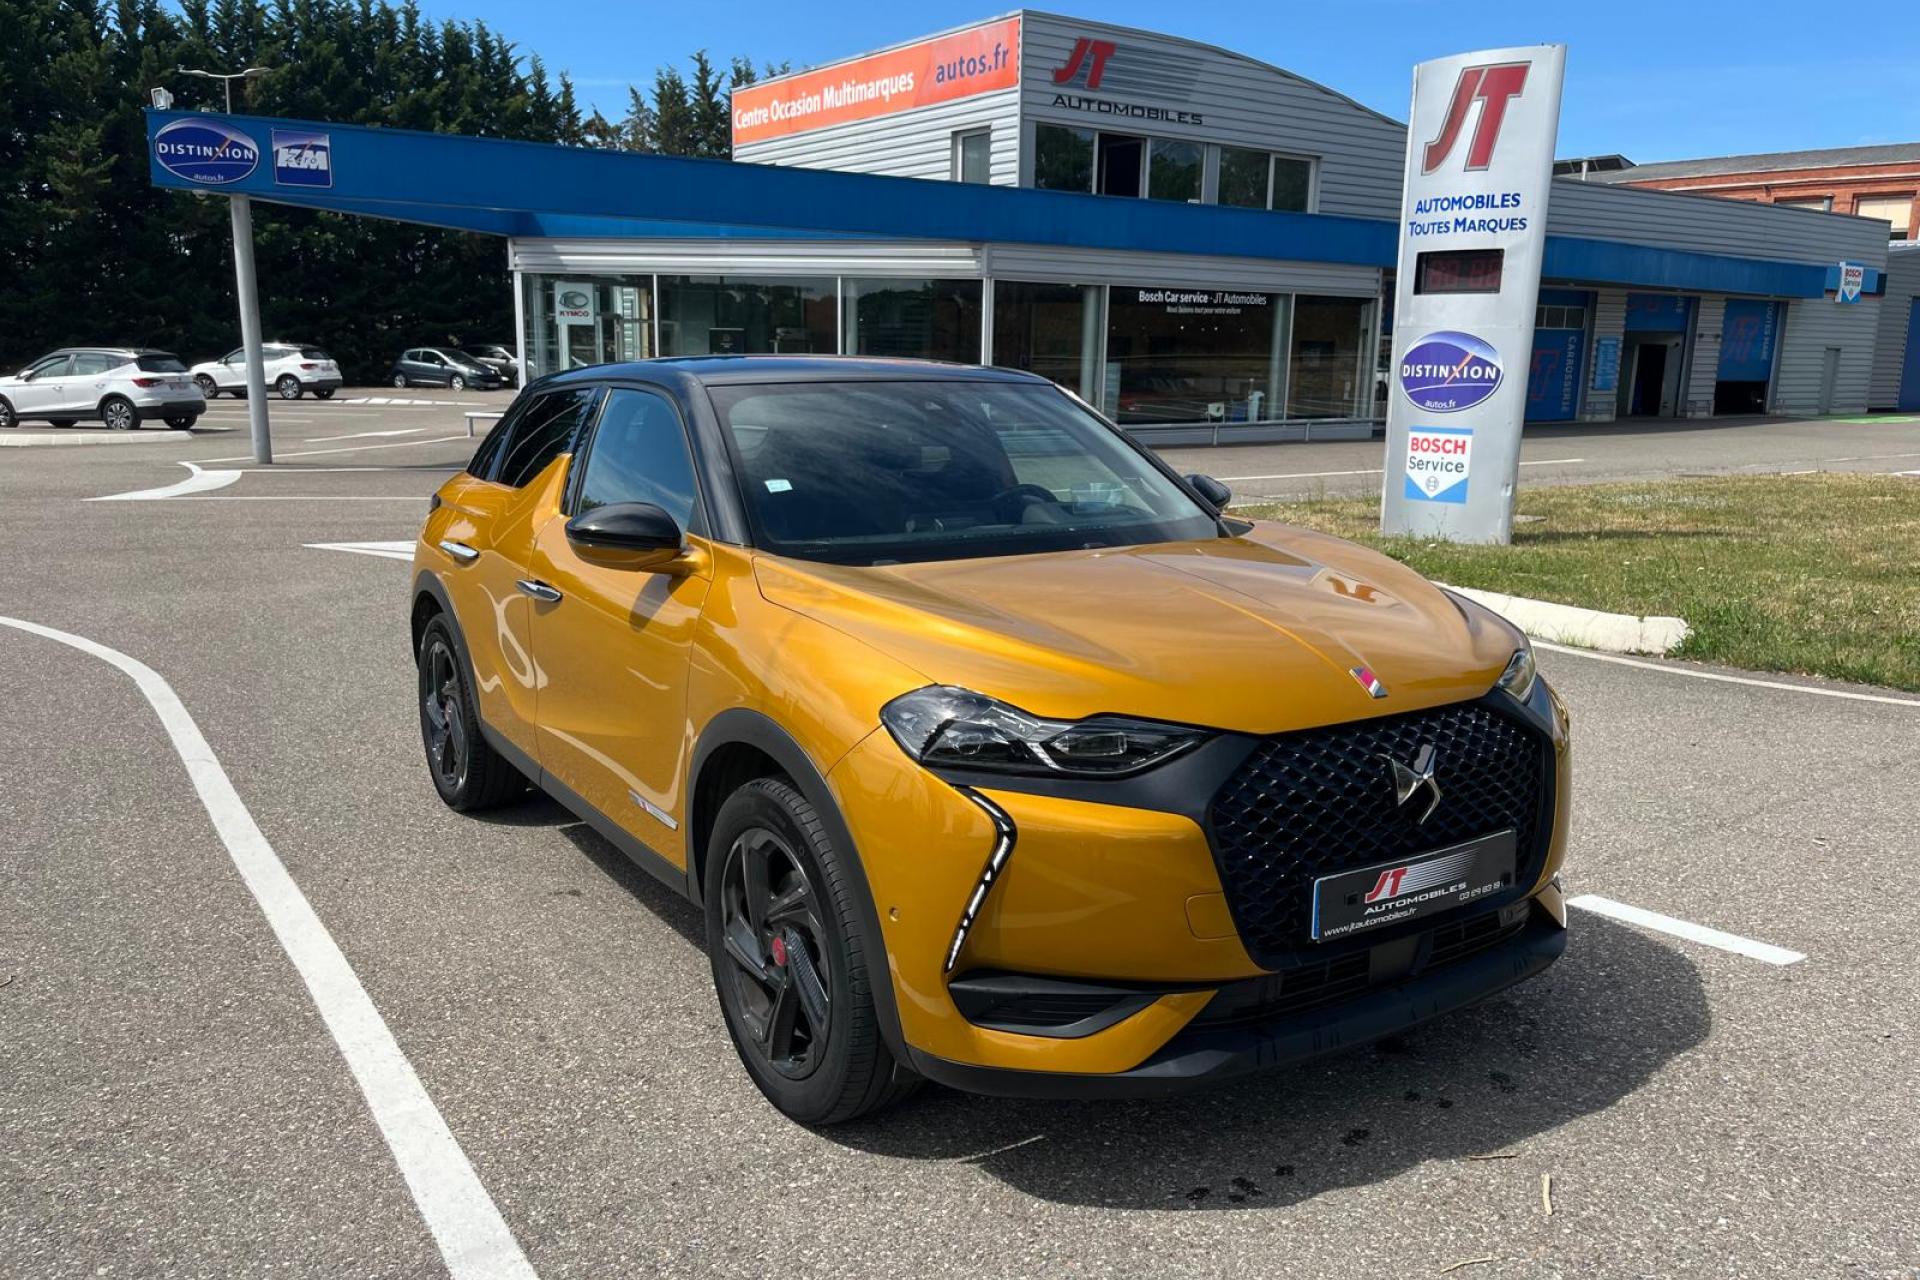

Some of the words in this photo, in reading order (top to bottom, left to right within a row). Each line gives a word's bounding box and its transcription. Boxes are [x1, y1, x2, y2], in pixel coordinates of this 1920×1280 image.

[935, 43, 1010, 84] autos.fr
[1053, 36, 1118, 91] JT
[735, 105, 769, 130] Centre
[770, 92, 821, 121] Occasion
[822, 70, 915, 111] Multimarques
[1052, 93, 1204, 126] AUTOMOBILES
[1421, 61, 1532, 176] JT
[158, 142, 254, 160] DISTINXION
[194, 172, 224, 182] autos.fr
[1415, 193, 1521, 214] AUTOMOBILES
[1845, 268, 1862, 278] BOSCH
[1138, 290, 1164, 302] Bosch
[1164, 290, 1179, 303] Car
[1180, 291, 1208, 304] service
[1212, 292, 1223, 304] JT
[1223, 293, 1267, 305] Automobiles
[1402, 364, 1497, 380] DISTINXION
[1425, 399, 1457, 409] autos.fr
[1410, 436, 1466, 455] BOSCH
[1408, 455, 1465, 474] Service
[1364, 866, 1408, 903] JT
[1364, 881, 1468, 915] AUTOMOBILES
[1323, 907, 1418, 938] www.jtautomobiles.fr
